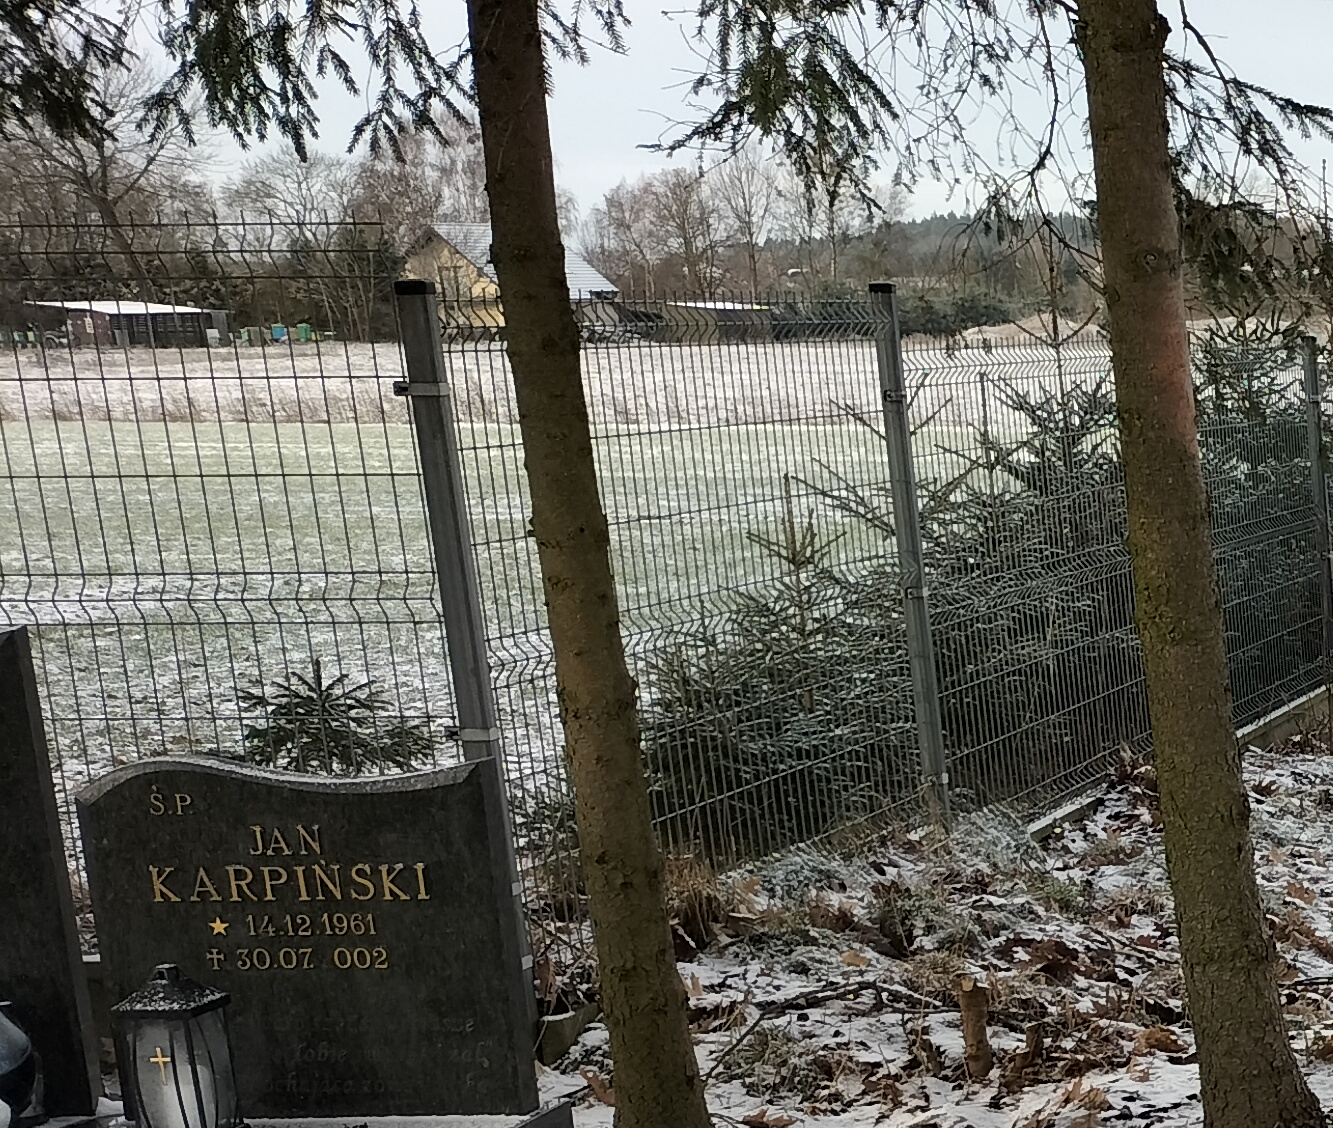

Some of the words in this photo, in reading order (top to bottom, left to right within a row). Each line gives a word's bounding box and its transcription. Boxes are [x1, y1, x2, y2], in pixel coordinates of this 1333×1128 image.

[248, 823, 323, 856] JAN
[148, 859, 431, 903] KARPIŃSKI
[245, 912, 378, 937] 14.12.1961
